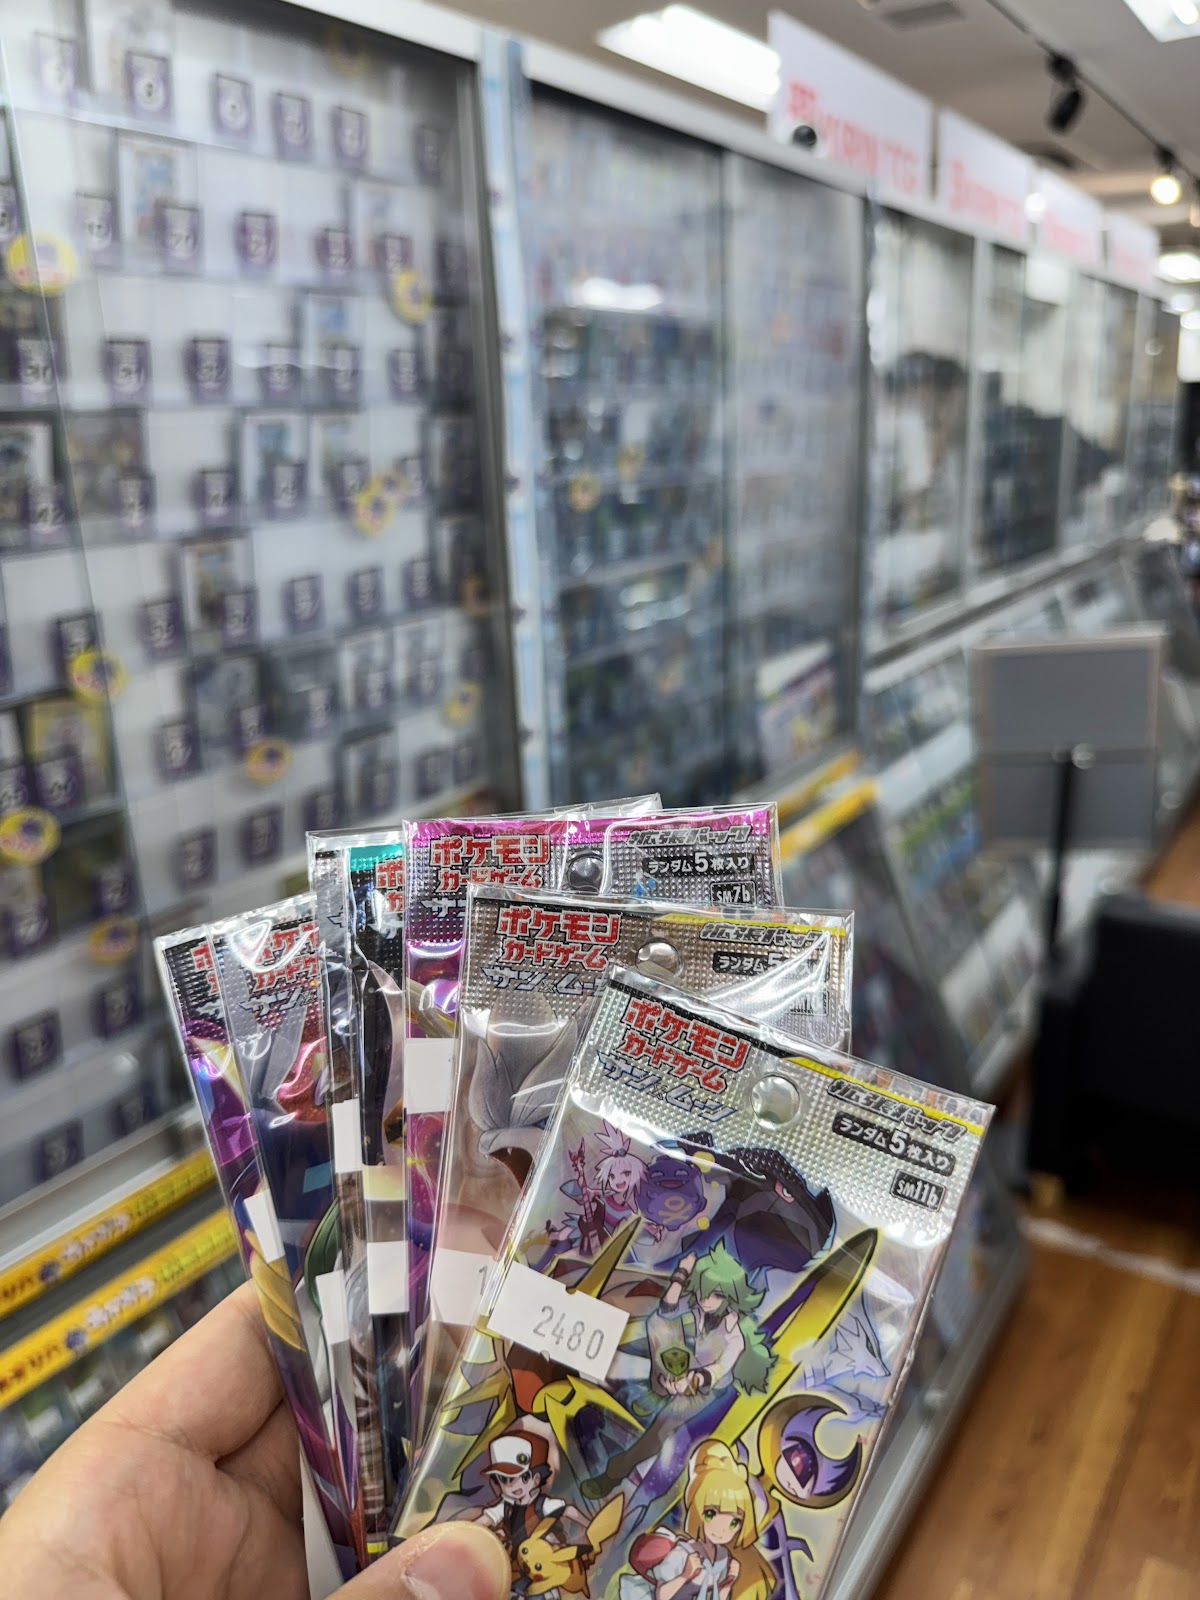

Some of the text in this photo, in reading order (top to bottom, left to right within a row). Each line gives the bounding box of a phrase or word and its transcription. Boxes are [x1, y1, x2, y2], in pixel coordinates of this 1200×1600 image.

[430, 835, 551, 867] ポケモン
[627, 825, 753, 847] 拡張パック
[648, 852, 749, 874] ランダム5枚入り
[497, 905, 623, 945] ポケモン
[502, 938, 610, 971] カードゲーム
[621, 997, 752, 1073] ポケモン
[618, 1030, 729, 1095] カードゲーム
[827, 1078, 967, 1143] 拡張パック
[839, 1117, 950, 1170] ランダム5枚入り
[533, 1305, 605, 1360] 2480
